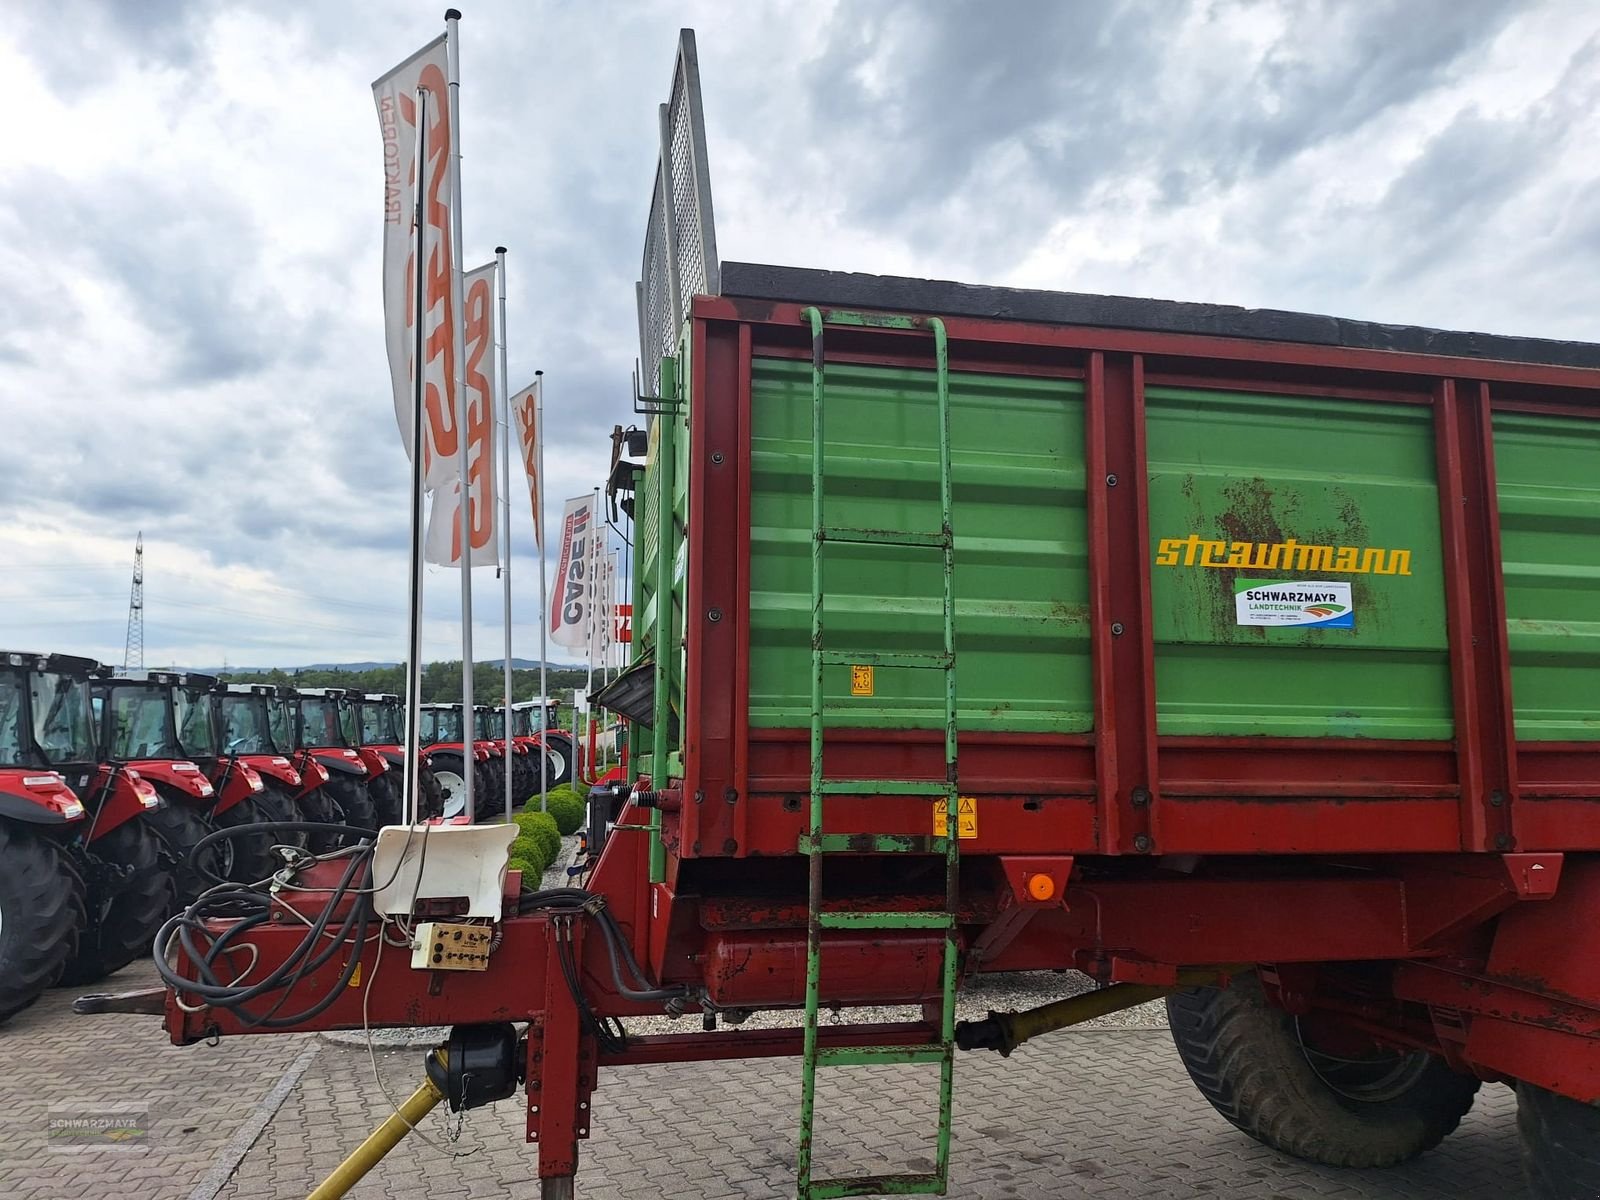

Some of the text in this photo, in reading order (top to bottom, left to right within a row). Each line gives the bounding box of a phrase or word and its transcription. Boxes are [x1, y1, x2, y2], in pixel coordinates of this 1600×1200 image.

[1155, 534, 1412, 576] strautmann
[1246, 591, 1337, 603] SCHWARZMAYR
[1248, 603, 1302, 611] LANDTECHNIK
